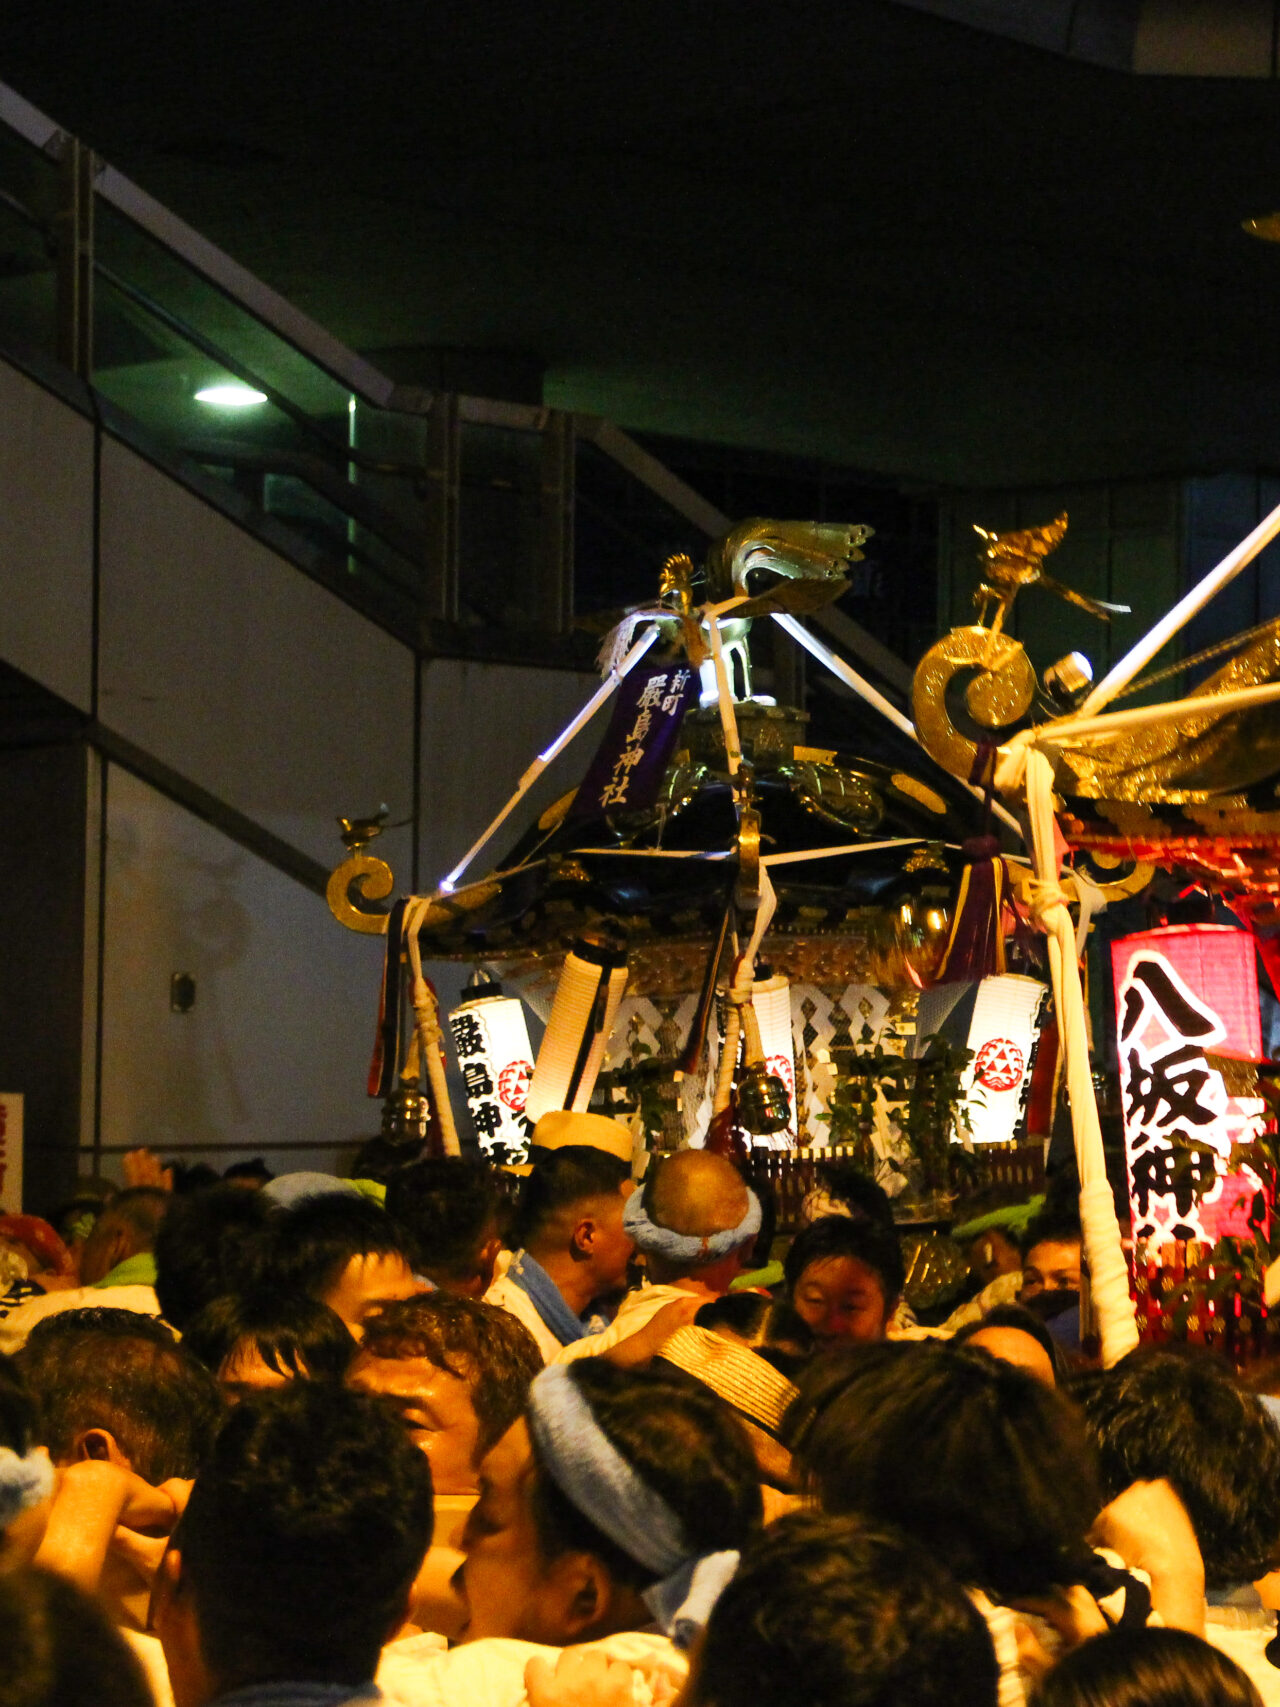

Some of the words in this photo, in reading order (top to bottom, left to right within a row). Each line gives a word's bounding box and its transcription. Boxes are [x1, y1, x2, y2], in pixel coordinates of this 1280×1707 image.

[661, 669, 691, 717] 新町
[1121, 960, 1219, 1241] 八坂神
